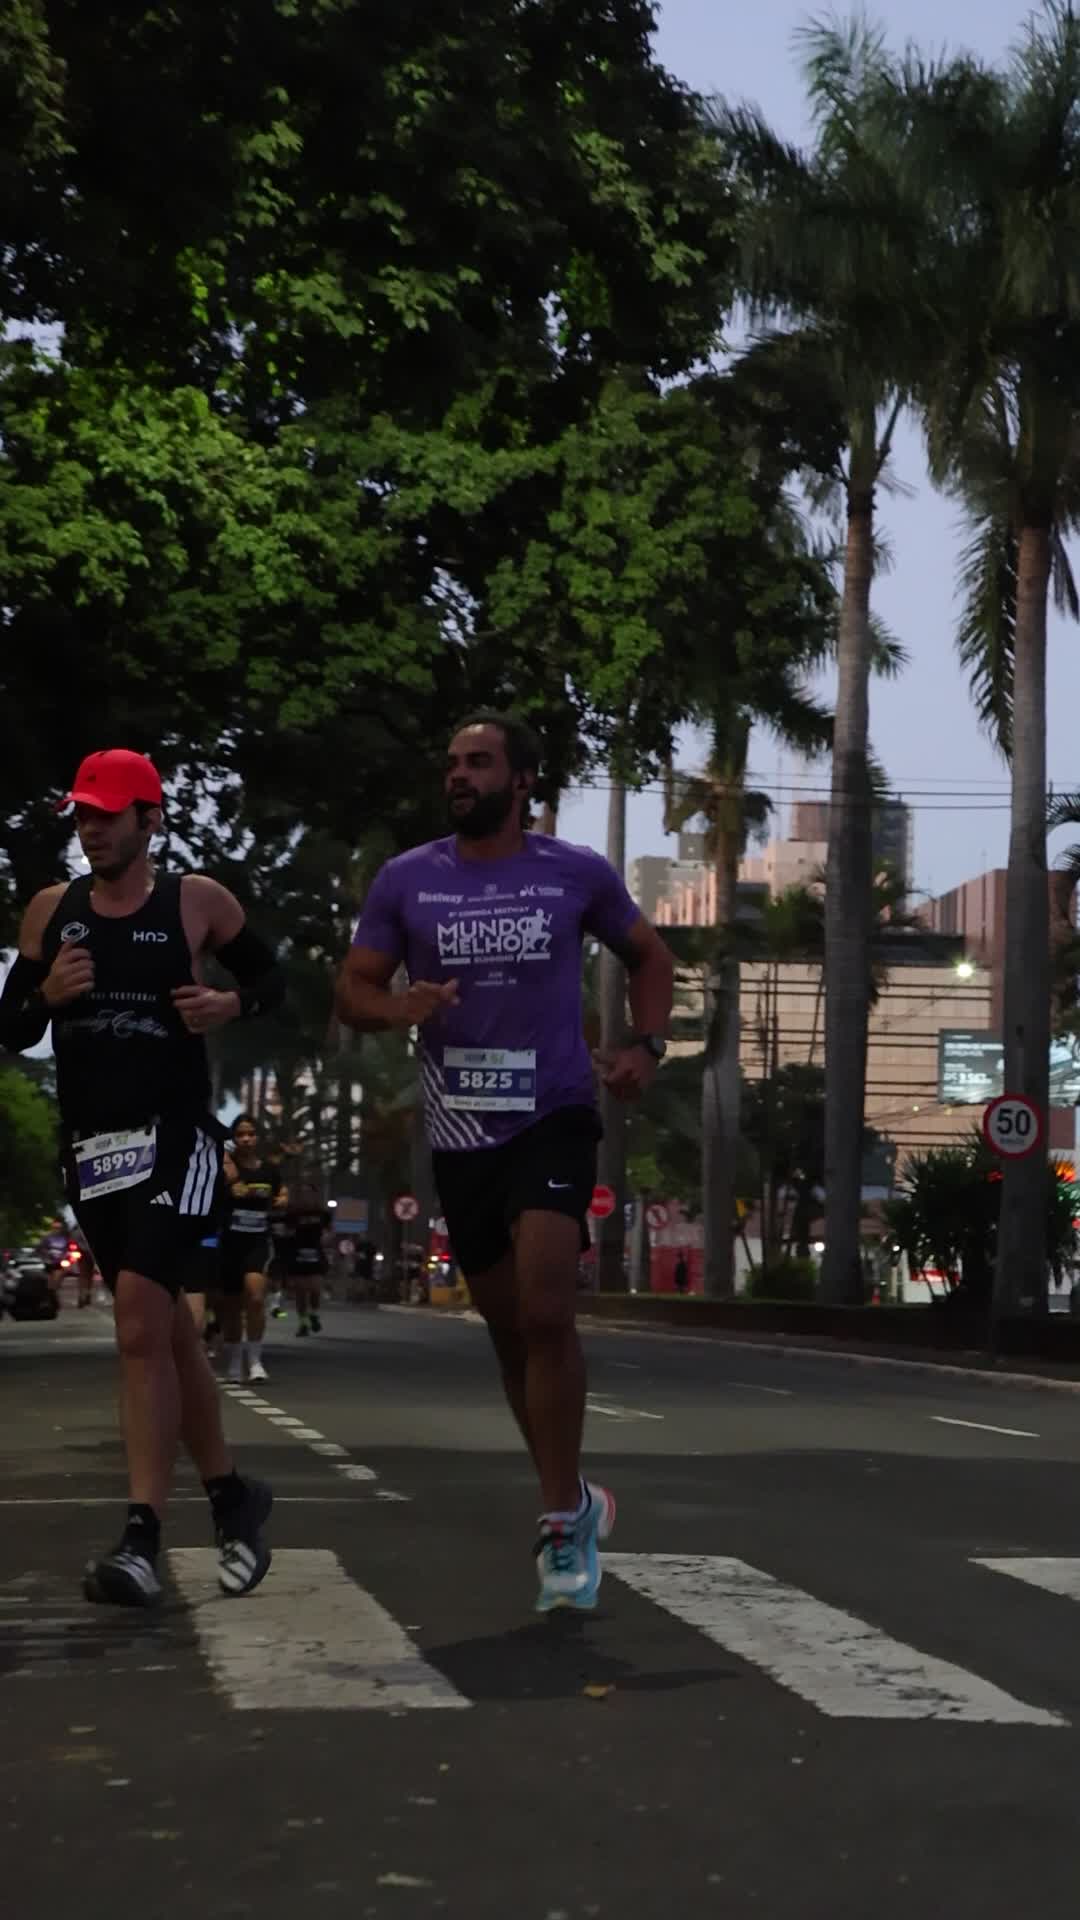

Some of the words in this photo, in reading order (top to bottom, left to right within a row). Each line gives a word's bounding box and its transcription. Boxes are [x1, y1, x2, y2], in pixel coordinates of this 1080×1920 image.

[437, 920, 536, 940] MUNDO
[439, 935, 536, 956] MELHOR
[459, 1071, 513, 1089] 5825
[997, 1108, 1031, 1136] 50
[93, 1151, 137, 1177] 5899
